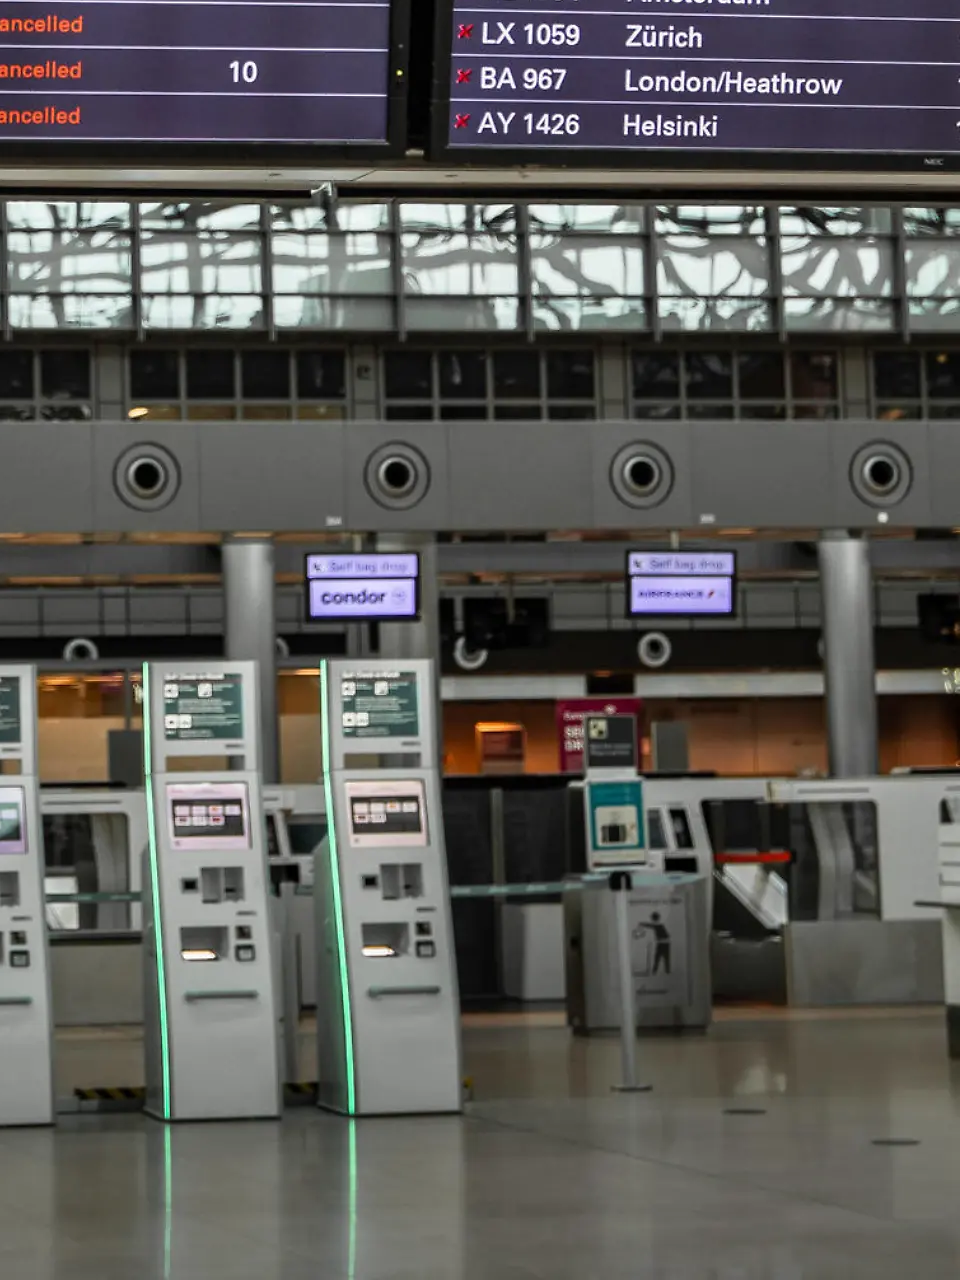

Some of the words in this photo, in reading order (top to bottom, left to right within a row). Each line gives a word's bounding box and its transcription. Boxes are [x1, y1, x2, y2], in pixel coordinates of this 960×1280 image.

[481, 21, 516, 45] LX
[523, 23, 581, 46] 1059
[624, 24, 703, 49] Zürich
[229, 60, 258, 83] 10
[476, 111, 516, 135] AY
[523, 112, 580, 135] 1426
[624, 113, 718, 137] Helsinki
[321, 588, 386, 605] condor
